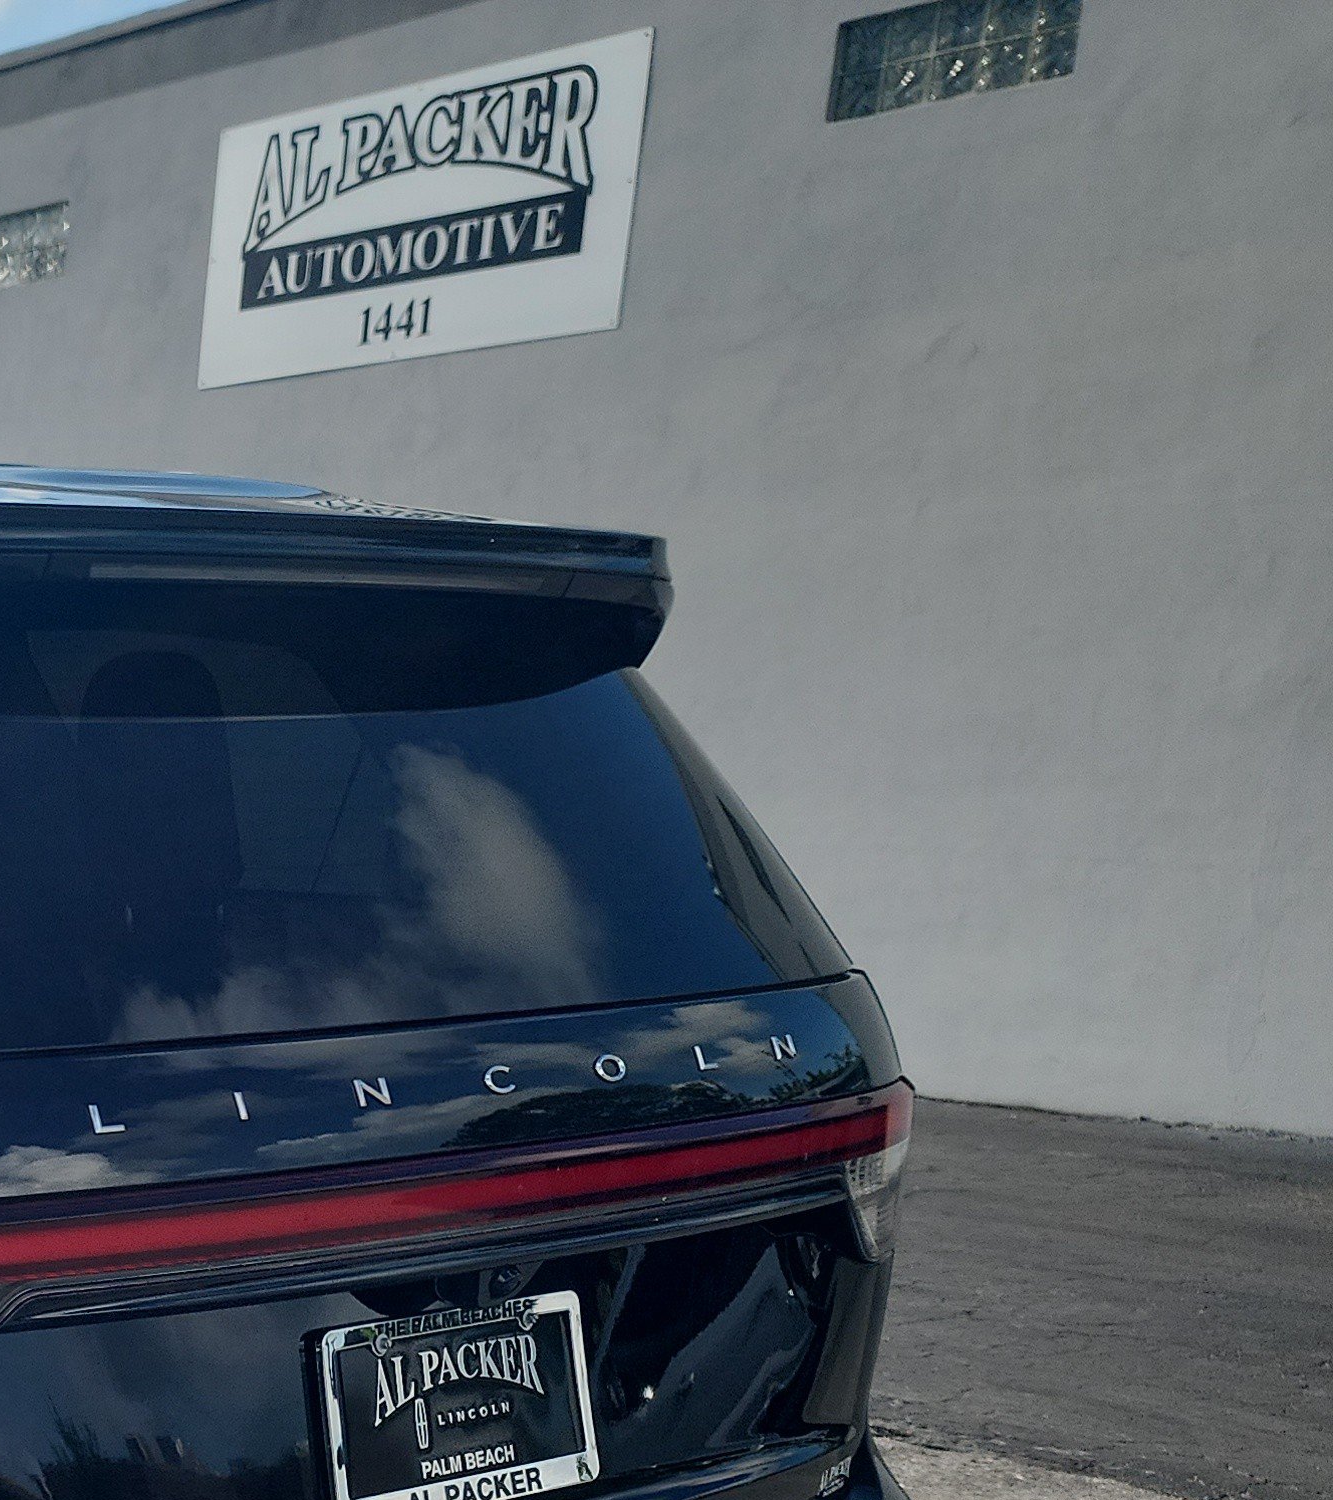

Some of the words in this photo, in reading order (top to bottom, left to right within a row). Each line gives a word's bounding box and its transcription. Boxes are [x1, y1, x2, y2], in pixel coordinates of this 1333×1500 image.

[244, 125, 331, 255] AL
[336, 64, 598, 197] PACKER
[256, 203, 565, 299] AUTOMOTIVE
[357, 297, 432, 348] 1441
[87, 1032, 798, 1136] LINCOLN
[374, 1355, 416, 1428] AL
[418, 1333, 546, 1396] PACKER
[437, 1401, 511, 1426] LINCOLN
[420, 1452, 464, 1480] PALM
[465, 1443, 516, 1471] BEACH
